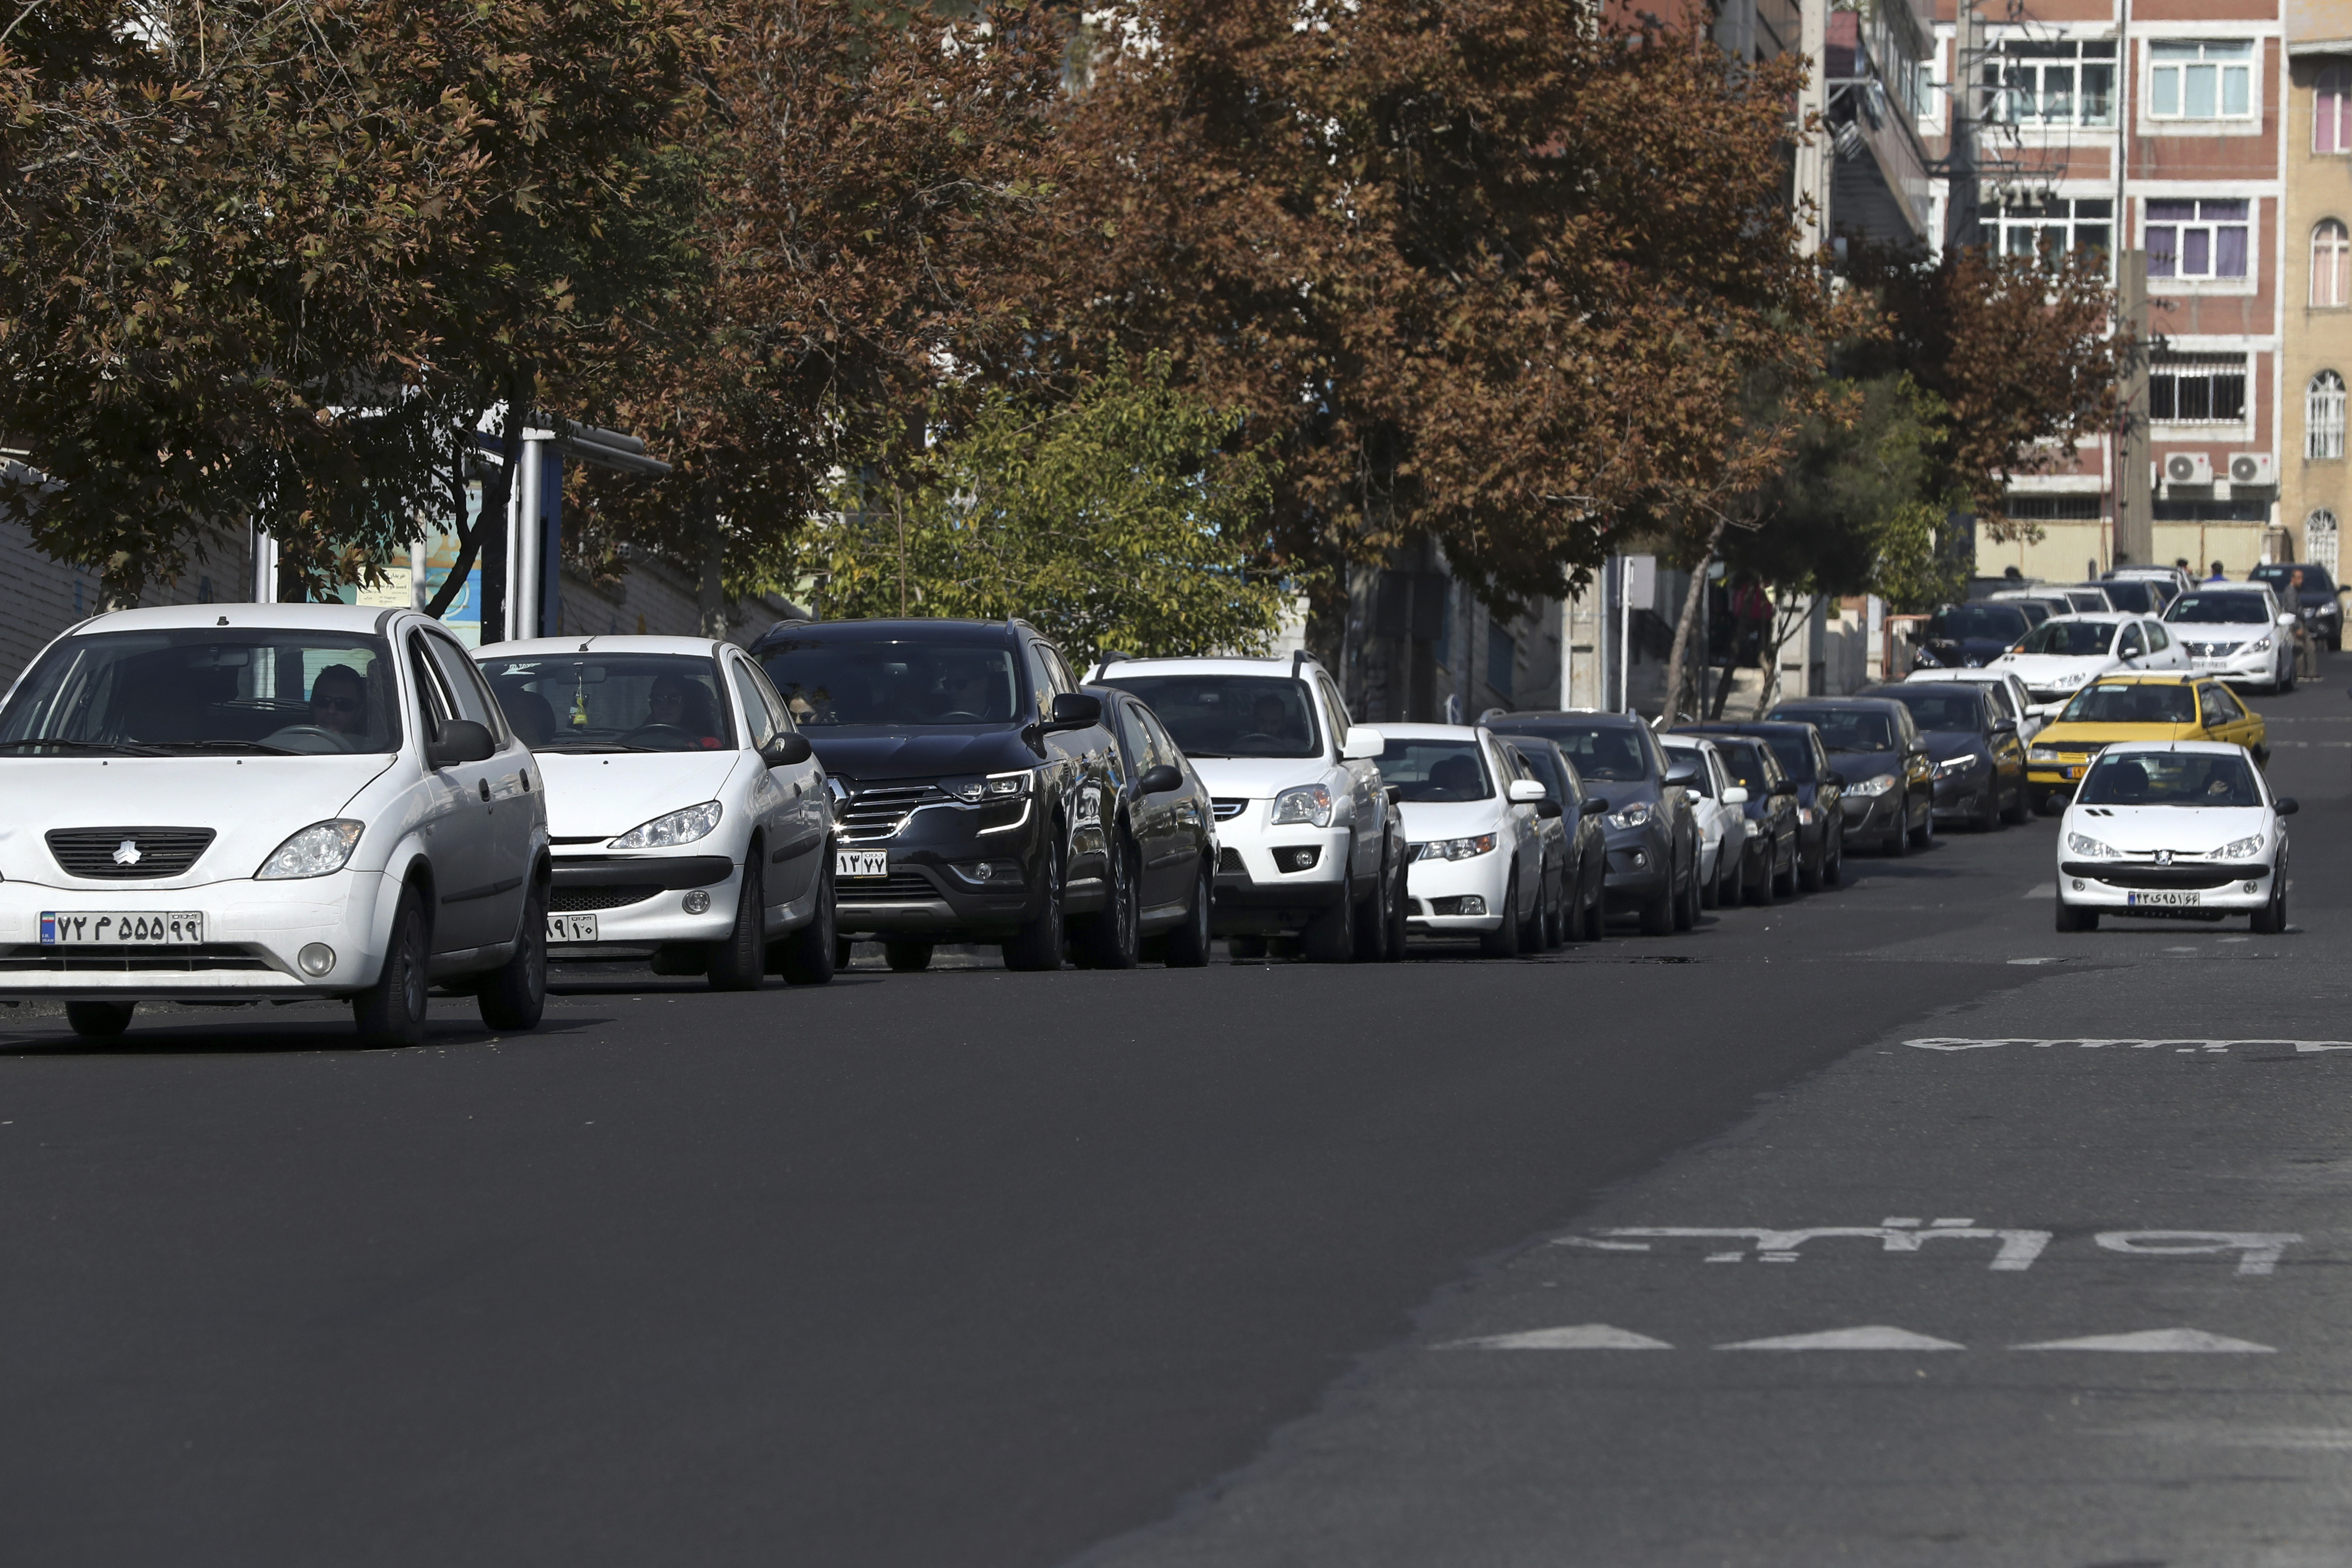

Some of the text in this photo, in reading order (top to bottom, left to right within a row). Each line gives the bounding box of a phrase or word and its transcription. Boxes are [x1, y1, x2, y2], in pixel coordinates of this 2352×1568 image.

[840, 855, 884, 873] ۱۳ ۷۷
[57, 915, 199, 942] ۷۲ م ۵۵۵ ۹۹
[572, 922, 593, 939] ۱۰
